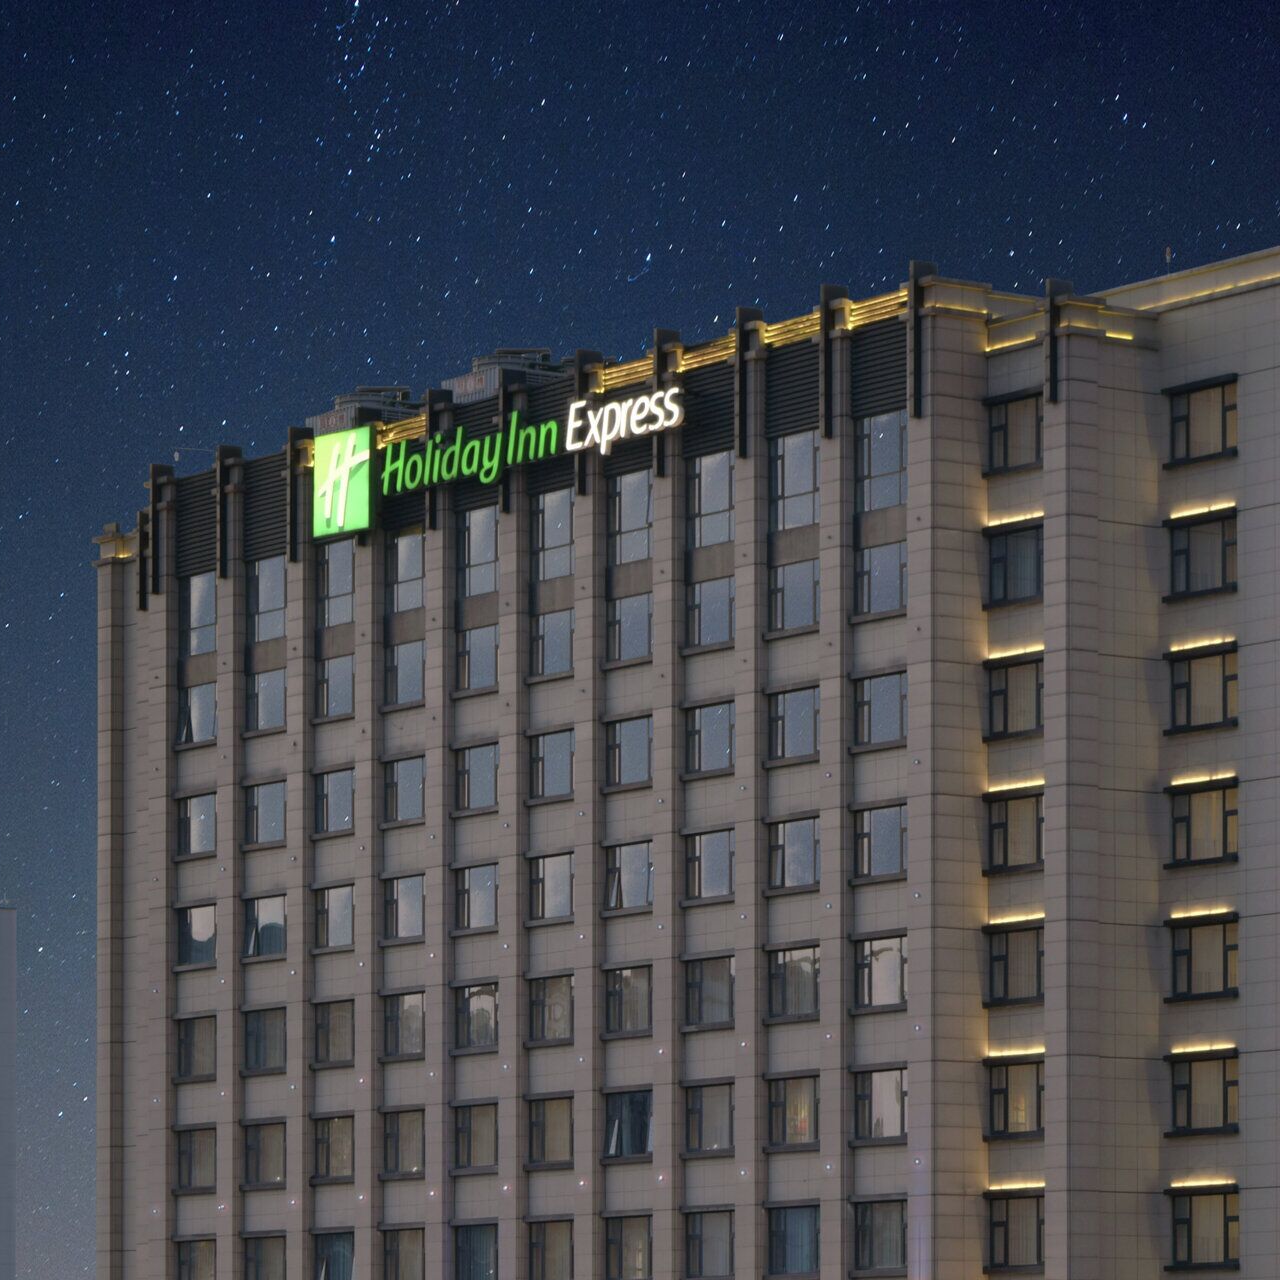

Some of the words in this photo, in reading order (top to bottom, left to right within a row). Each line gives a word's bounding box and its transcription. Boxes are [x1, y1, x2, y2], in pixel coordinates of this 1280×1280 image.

[382, 426, 502, 496] Holiday
[506, 410, 558, 464] Inn
[566, 387, 683, 455] Express
